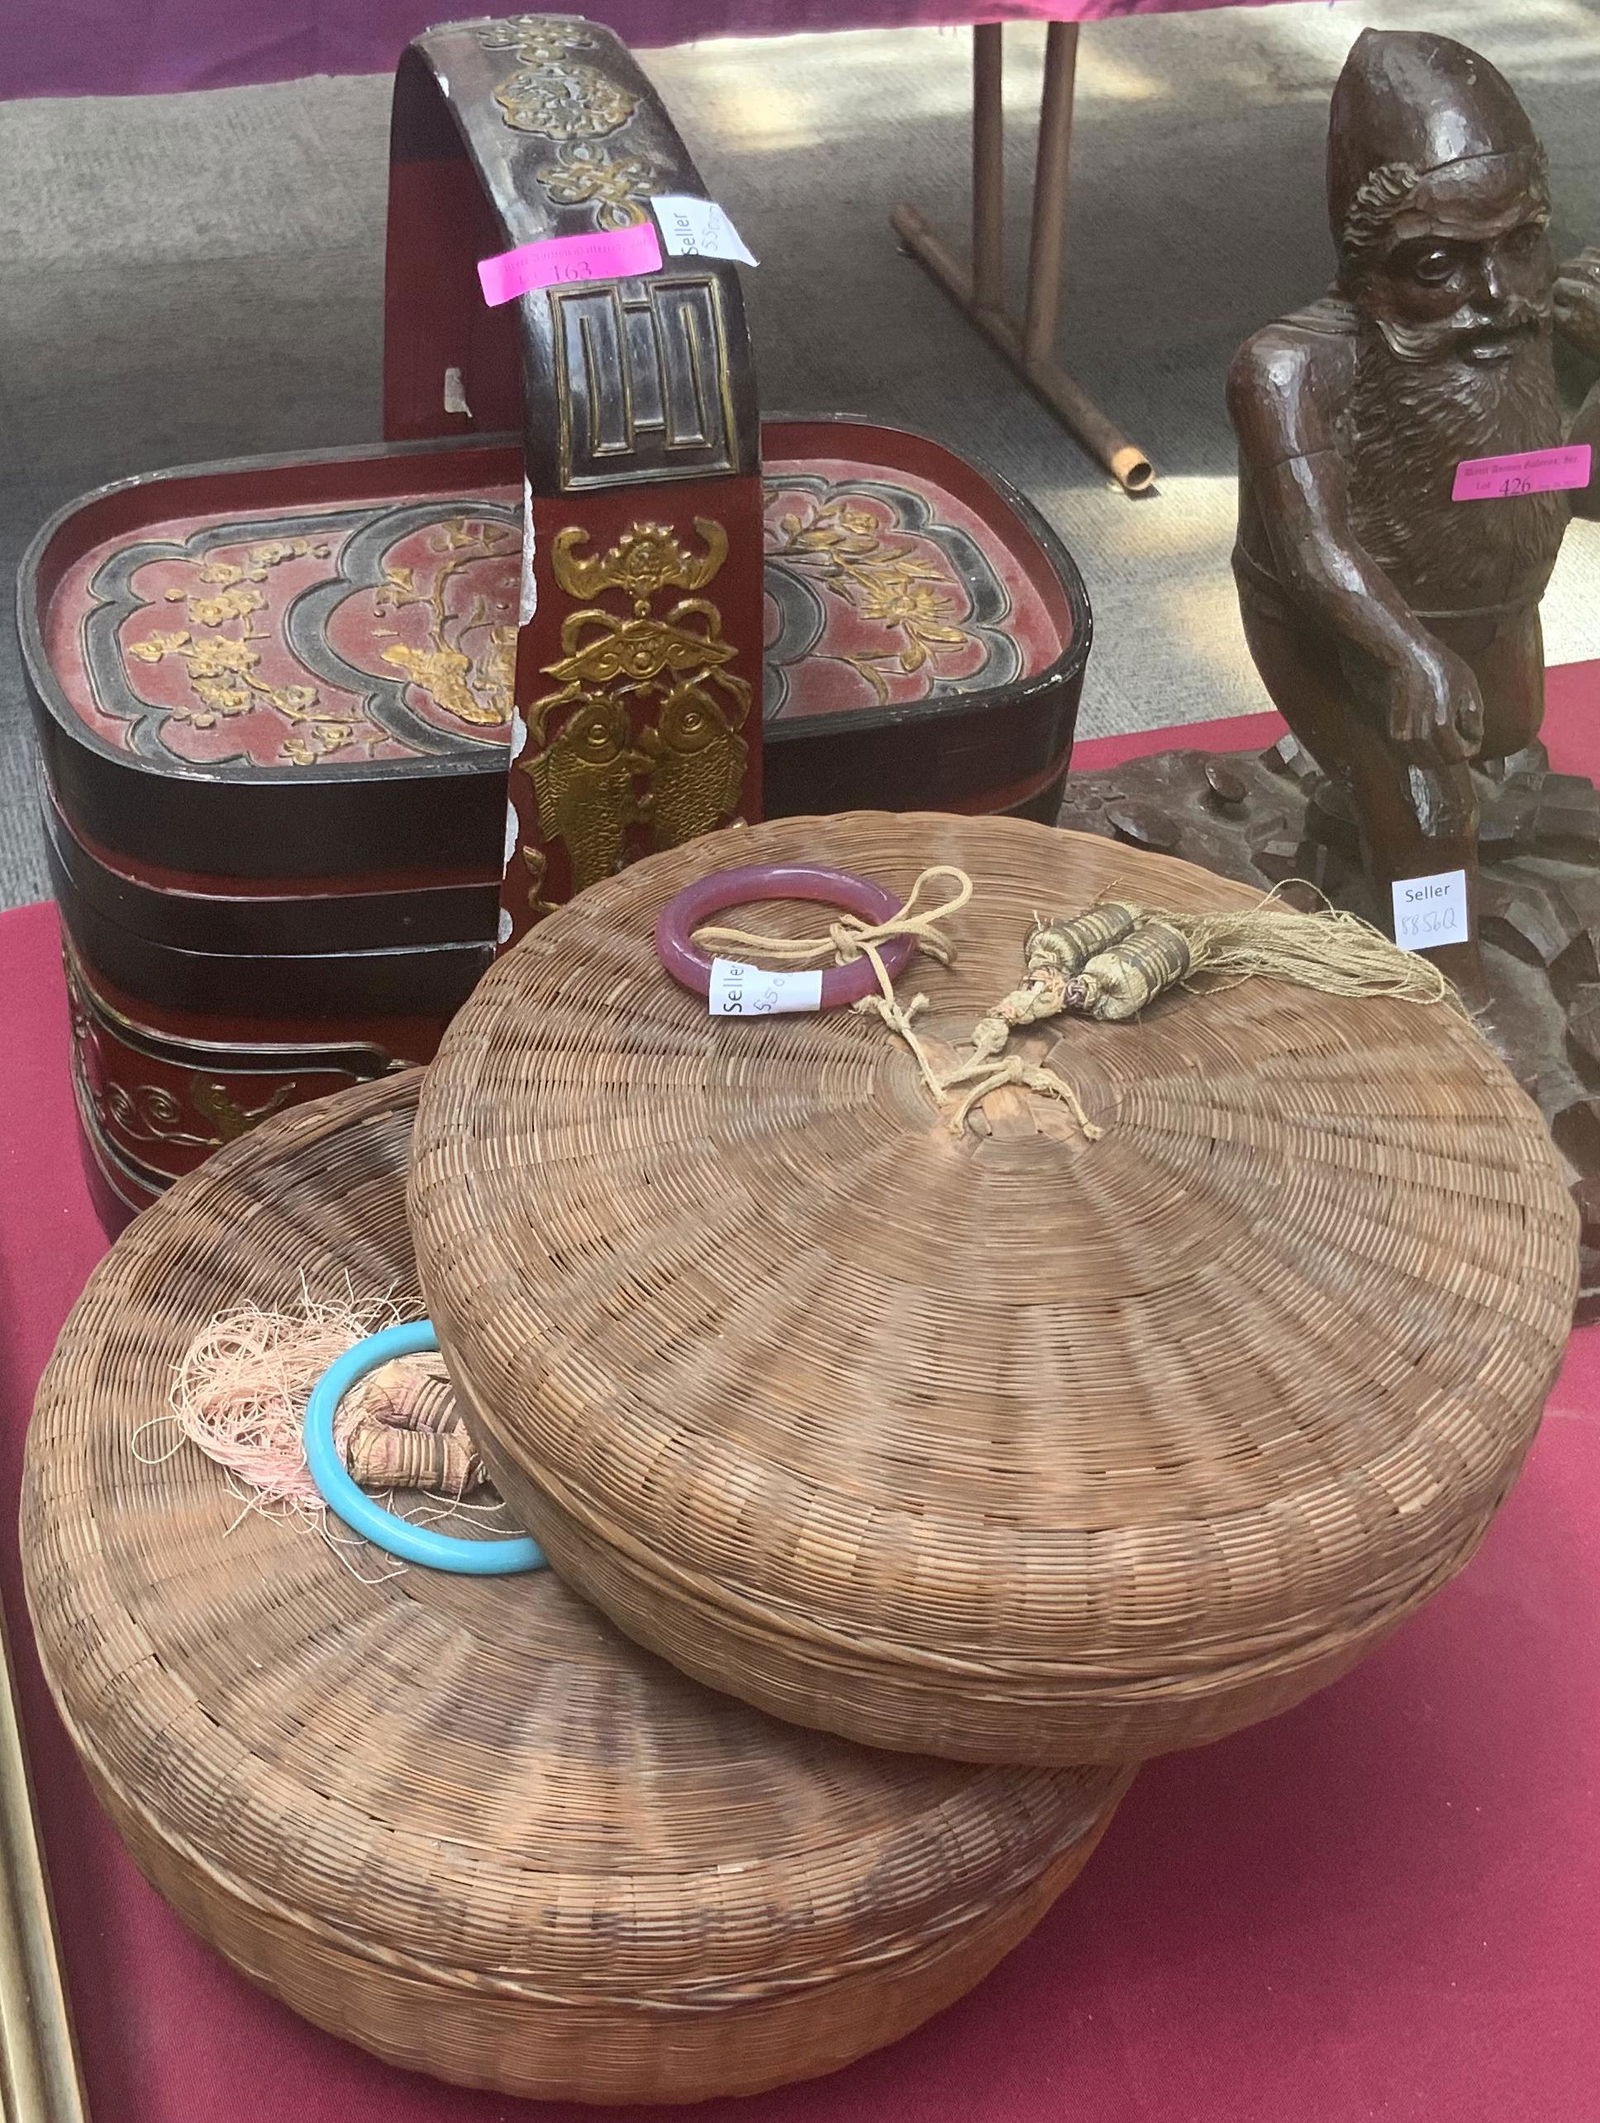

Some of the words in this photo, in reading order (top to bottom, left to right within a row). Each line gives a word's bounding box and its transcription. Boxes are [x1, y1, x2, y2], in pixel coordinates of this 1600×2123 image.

[673, 212, 699, 256] Seller
[551, 261, 593, 282] 163
[1499, 477, 1531, 496] 426
[1405, 885, 1451, 903] Seller
